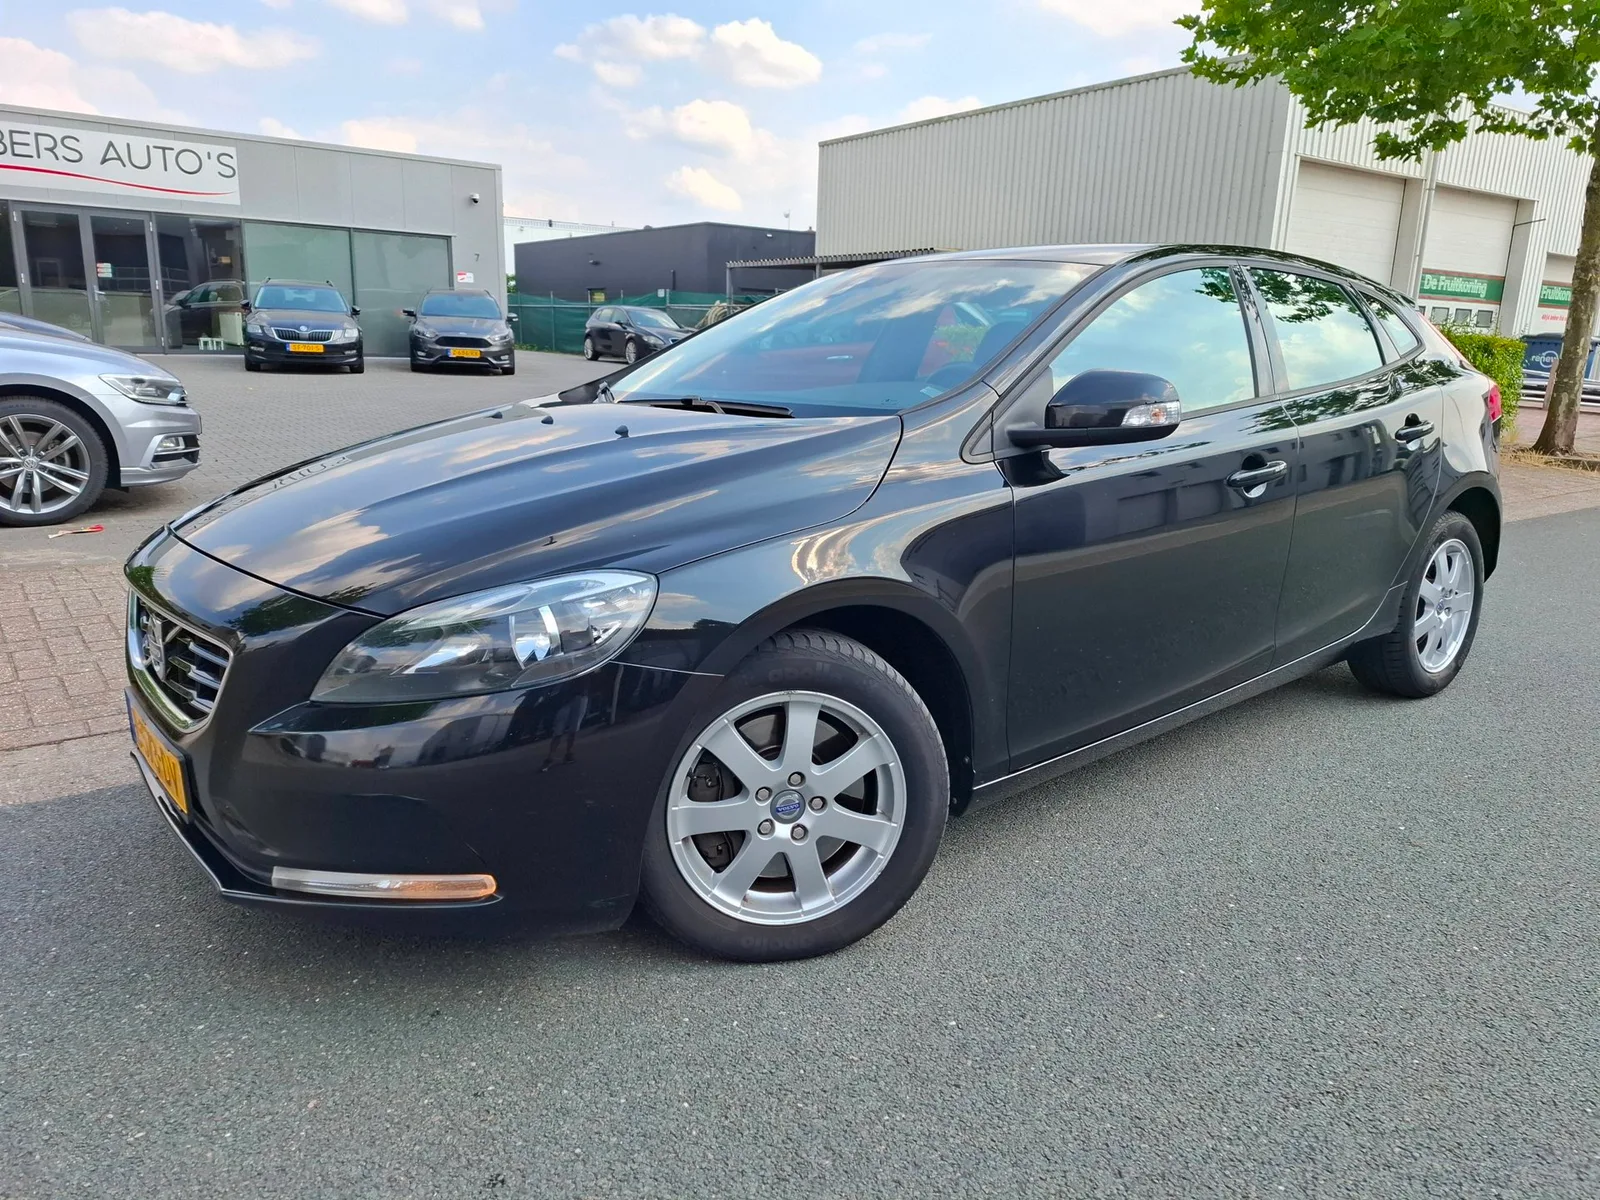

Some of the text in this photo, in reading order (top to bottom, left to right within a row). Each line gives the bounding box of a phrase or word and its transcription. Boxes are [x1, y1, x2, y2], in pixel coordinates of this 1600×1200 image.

[0, 129, 236, 178] ERS AUTO'S
[474, 253, 480, 262] 7
[1423, 274, 1488, 298] De Fruitkoning
[1541, 285, 1571, 302] Fruitkon
[777, 803, 799, 812] VOLVO
